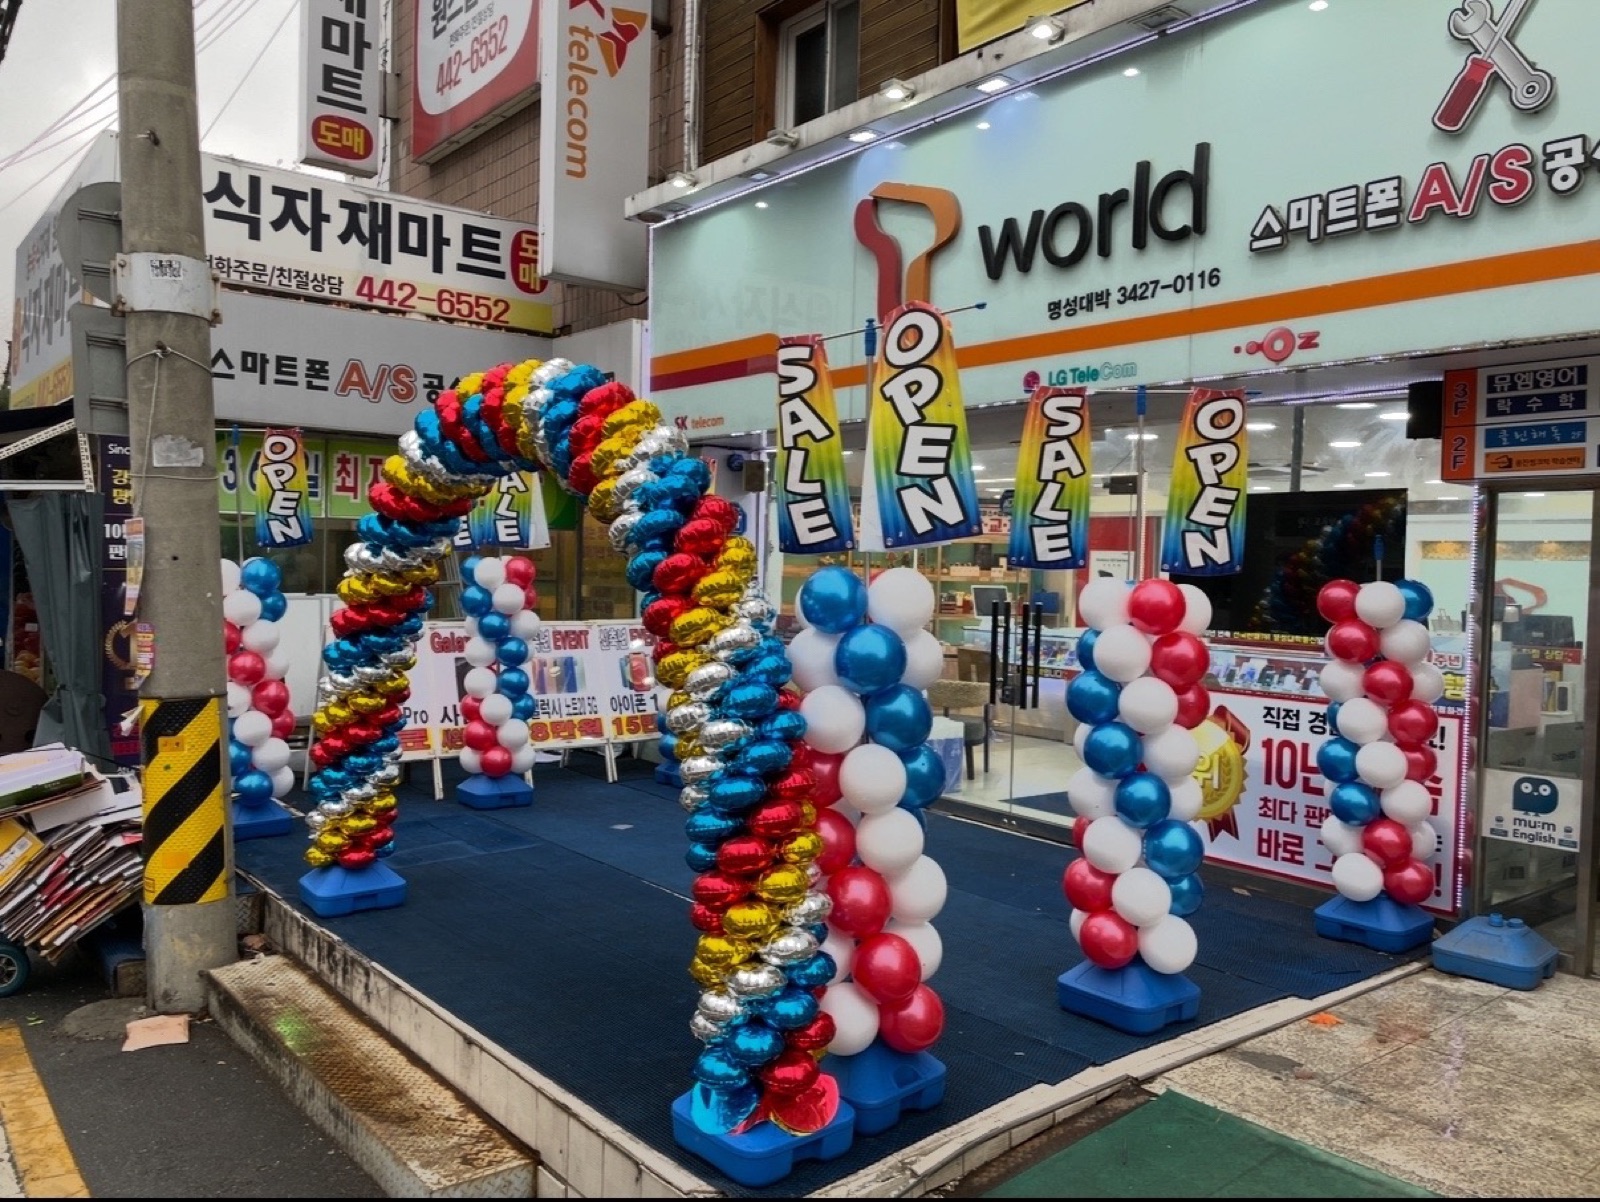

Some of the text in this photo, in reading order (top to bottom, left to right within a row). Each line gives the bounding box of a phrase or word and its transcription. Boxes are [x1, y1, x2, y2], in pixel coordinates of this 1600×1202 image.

[436, 14, 508, 96] 442-6552
[566, 25, 598, 179] telecom
[317, 120, 365, 155] 도매
[978, 143, 1210, 281] world
[1250, 133, 1600, 252] 스마트폰 A/S 공
[203, 170, 506, 281] 식자재마트
[356, 275, 511, 325] 442-6552
[1047, 267, 1221, 321] 명성대박 3427-0116
[211, 348, 330, 392] 스마트폰
[336, 358, 418, 403] A/S
[1048, 369, 1068, 387] LG
[107, 443, 131, 455] Sinc
[691, 415, 724, 430] telecom
[777, 343, 839, 546] SALE
[881, 308, 966, 537] OPEN
[261, 434, 303, 544] OPEN
[1029, 396, 1086, 563] SALE
[1182, 397, 1246, 570] OPEN
[495, 472, 529, 543] ALE
[552, 630, 590, 650] EVENT
[610, 694, 647, 715] 아이폰
[1262, 705, 1300, 731] 직접
[1258, 796, 1335, 830] 최다 판
[1512, 828, 1556, 845] English
[1256, 827, 1305, 866] 바로
